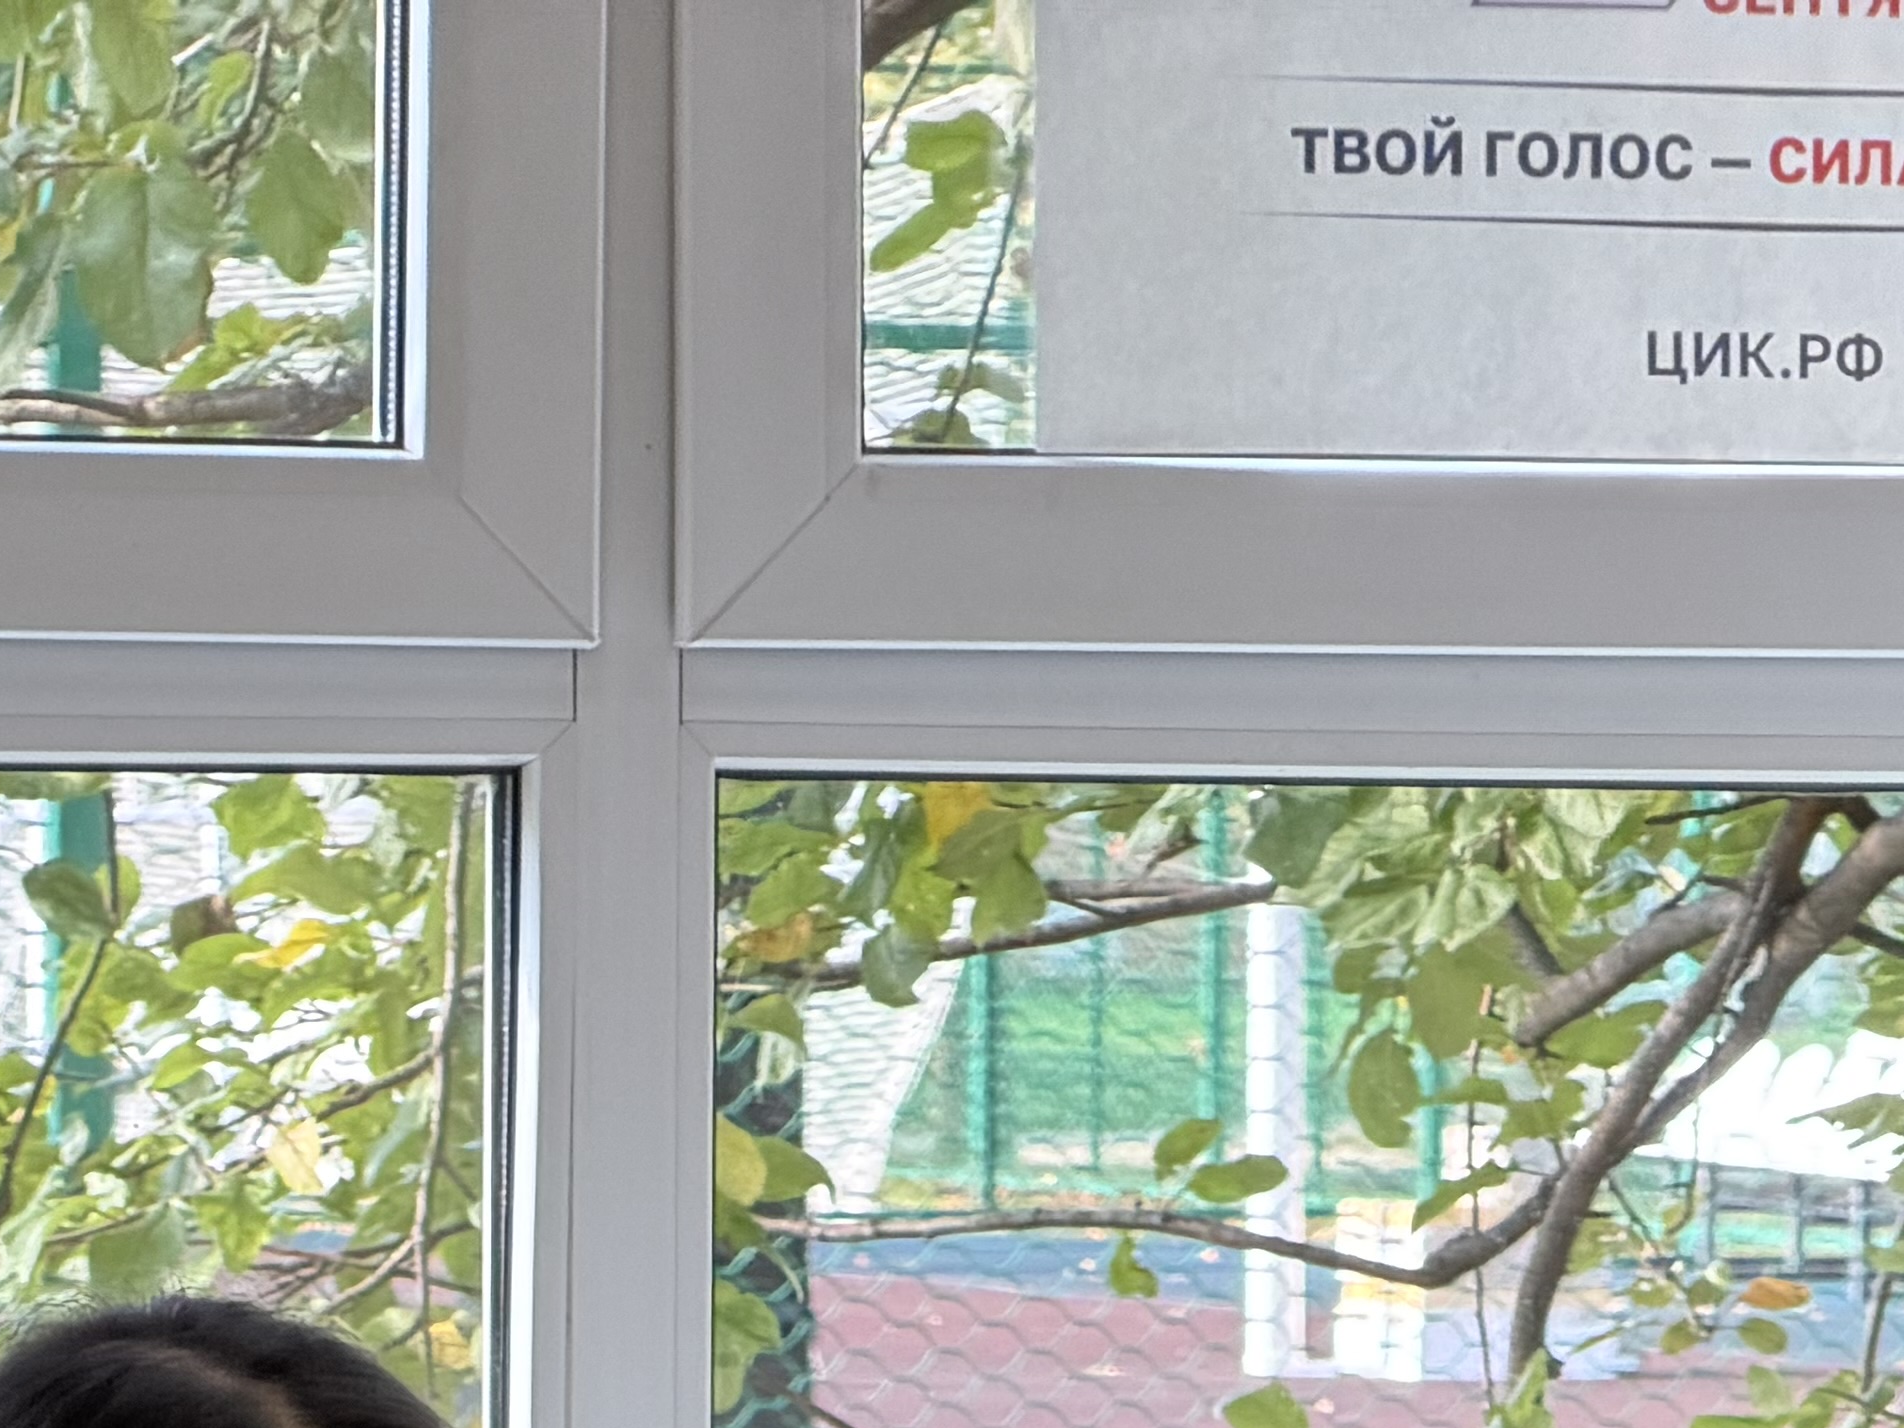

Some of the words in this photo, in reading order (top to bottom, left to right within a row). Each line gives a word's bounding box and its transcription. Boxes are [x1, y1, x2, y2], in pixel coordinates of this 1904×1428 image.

[1290, 114, 1463, 177] ТВОЙ
[1485, 130, 1694, 181] ГОЛОС
[1647, 330, 1884, 385] ЦИК.РФ
